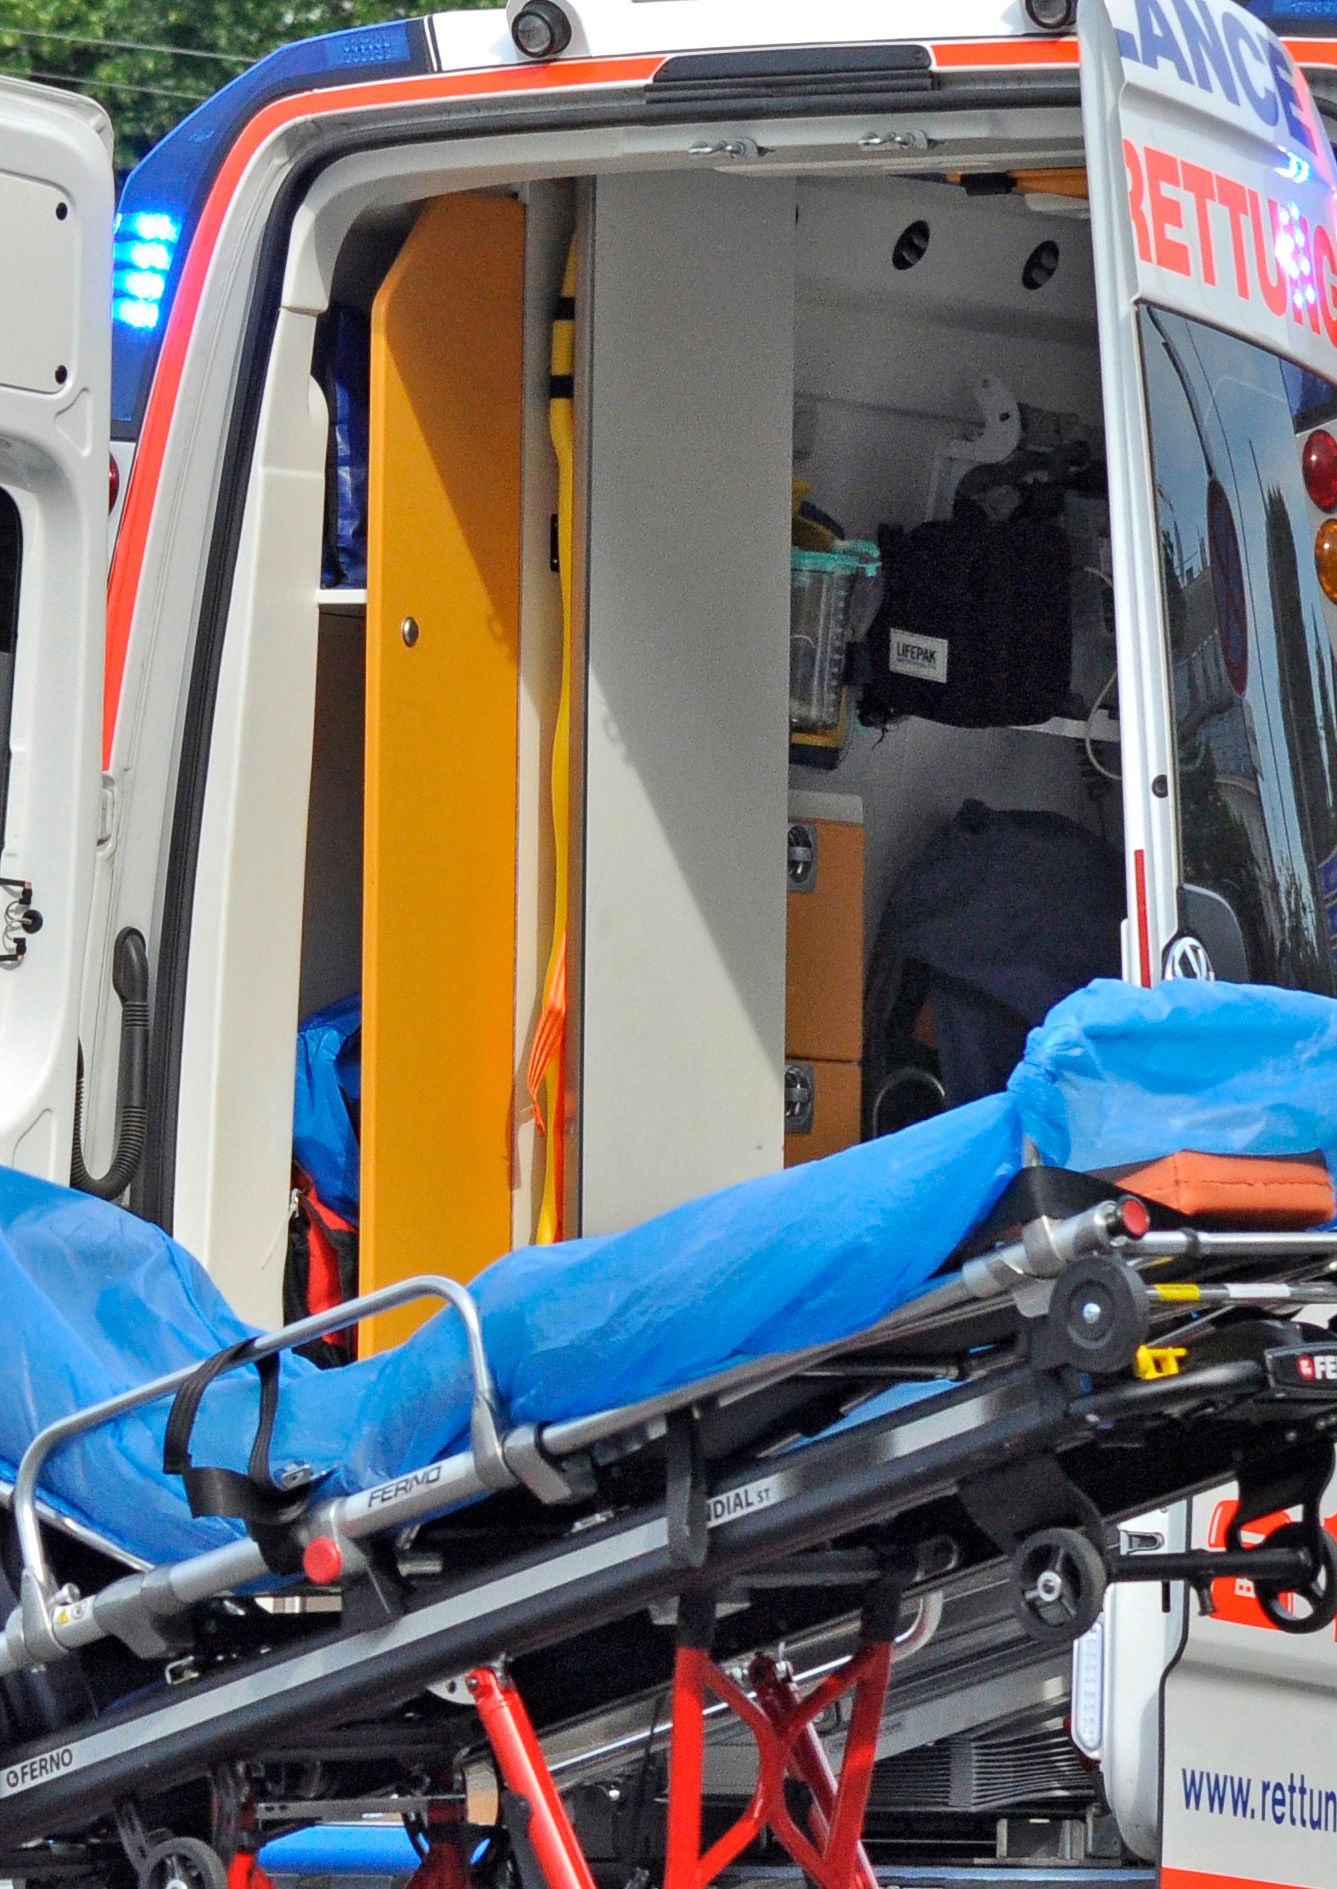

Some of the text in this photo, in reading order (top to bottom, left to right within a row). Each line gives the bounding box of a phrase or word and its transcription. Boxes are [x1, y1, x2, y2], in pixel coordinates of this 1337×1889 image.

[1114, 0, 1319, 156] ANCE
[896, 641, 937, 664] LIFEPAK
[367, 1465, 442, 1508] FERNO
[708, 1487, 770, 1521] DIAL ST
[20, 1748, 74, 1785] FERNO
